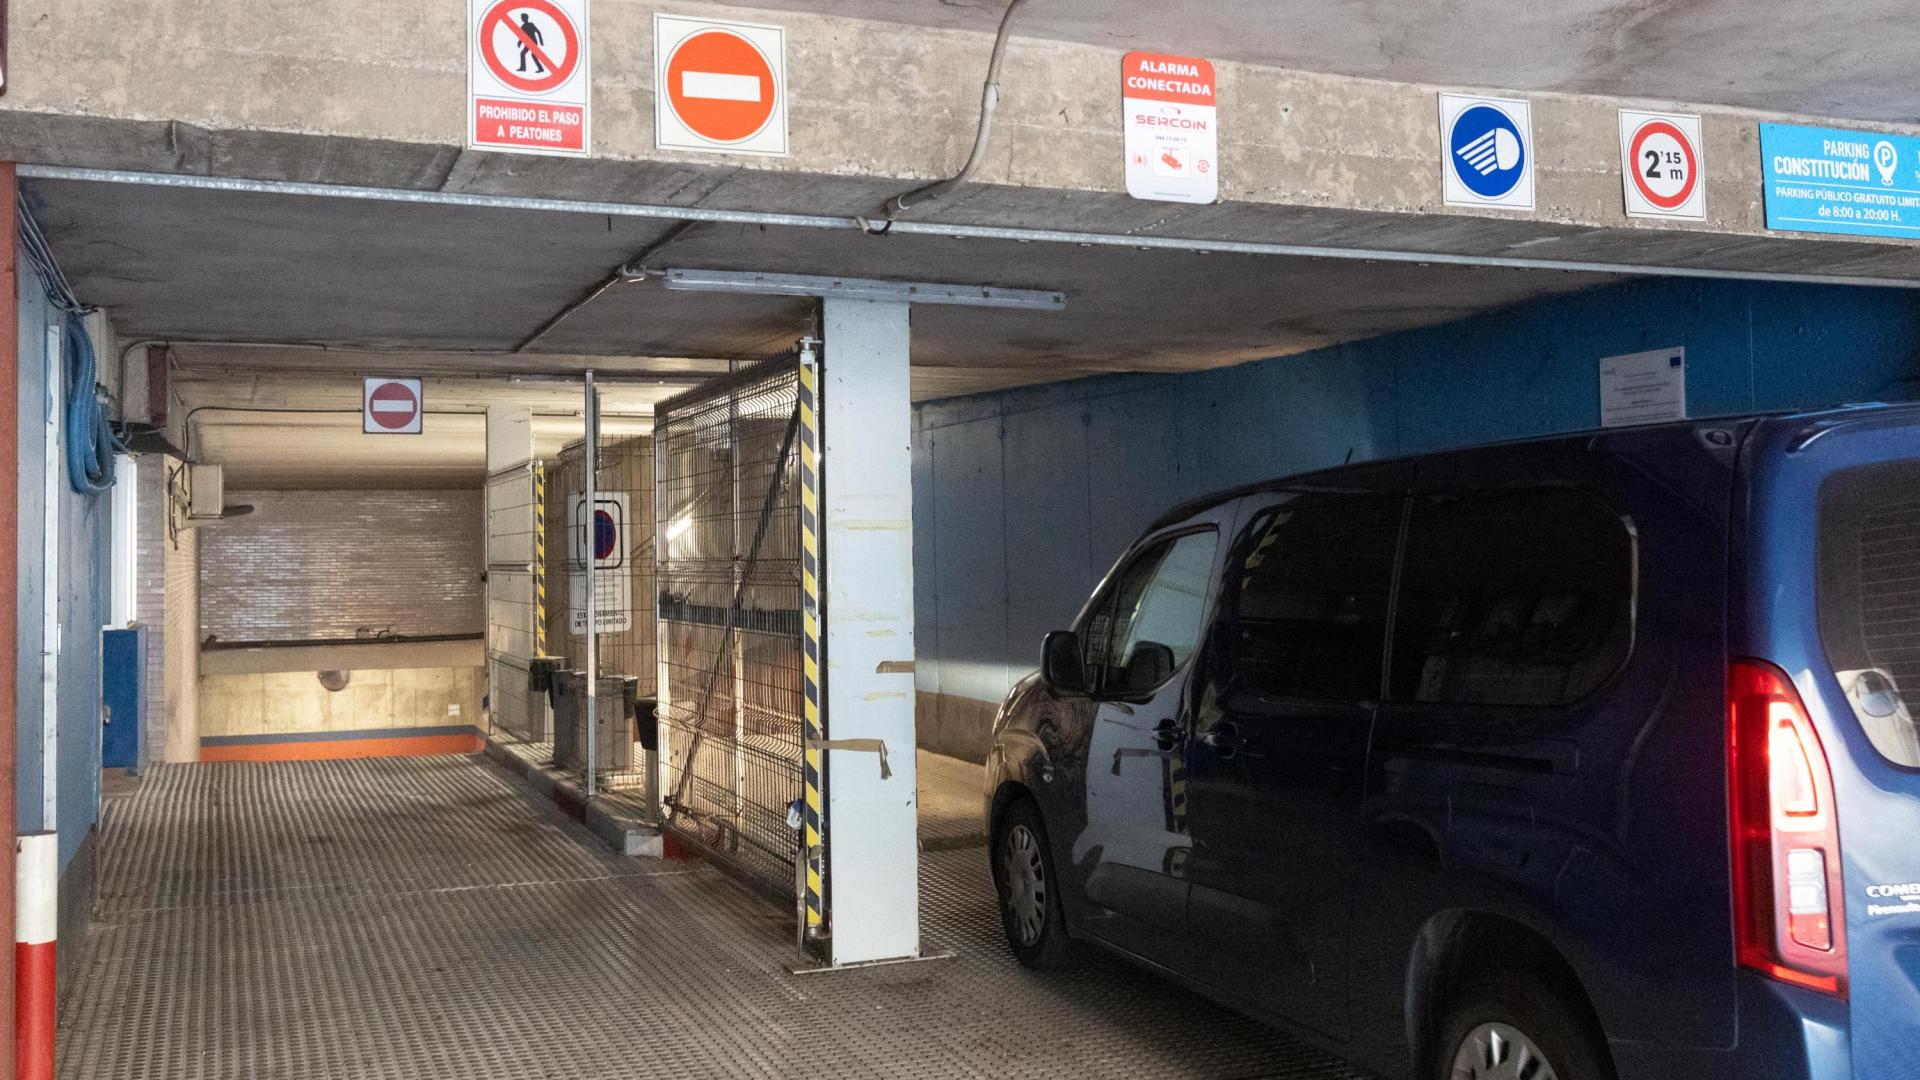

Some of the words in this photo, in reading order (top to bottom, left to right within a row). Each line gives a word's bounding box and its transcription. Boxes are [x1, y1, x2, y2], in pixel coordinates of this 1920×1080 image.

[1139, 60, 1199, 77] ALARMA
[1127, 76, 1212, 96] CONECTADA
[479, 105, 536, 122] PROHIBIDO
[538, 110, 551, 123] EL
[552, 112, 580, 126] PASO
[497, 125, 505, 137] A
[509, 126, 562, 142] PEATONES
[1823, 140, 1869, 159] PARKING
[1881, 148, 1891, 166] P
[1670, 169, 1683, 180] m
[1774, 156, 1870, 181] CONSTITUCIÓN
[1775, 187, 1814, 198] PARKING
[1816, 188, 1852, 202] PÚBLICO
[1854, 192, 1897, 206] GRATUITO
[1898, 196, 1920, 208] LIMIT
[1818, 205, 1831, 217] de
[1833, 207, 1854, 219] 8:00
[1855, 211, 1862, 219] a
[1863, 208, 1889, 220] 20:00
[1891, 211, 1902, 222] H.
[1866, 883, 1920, 898] COMB
